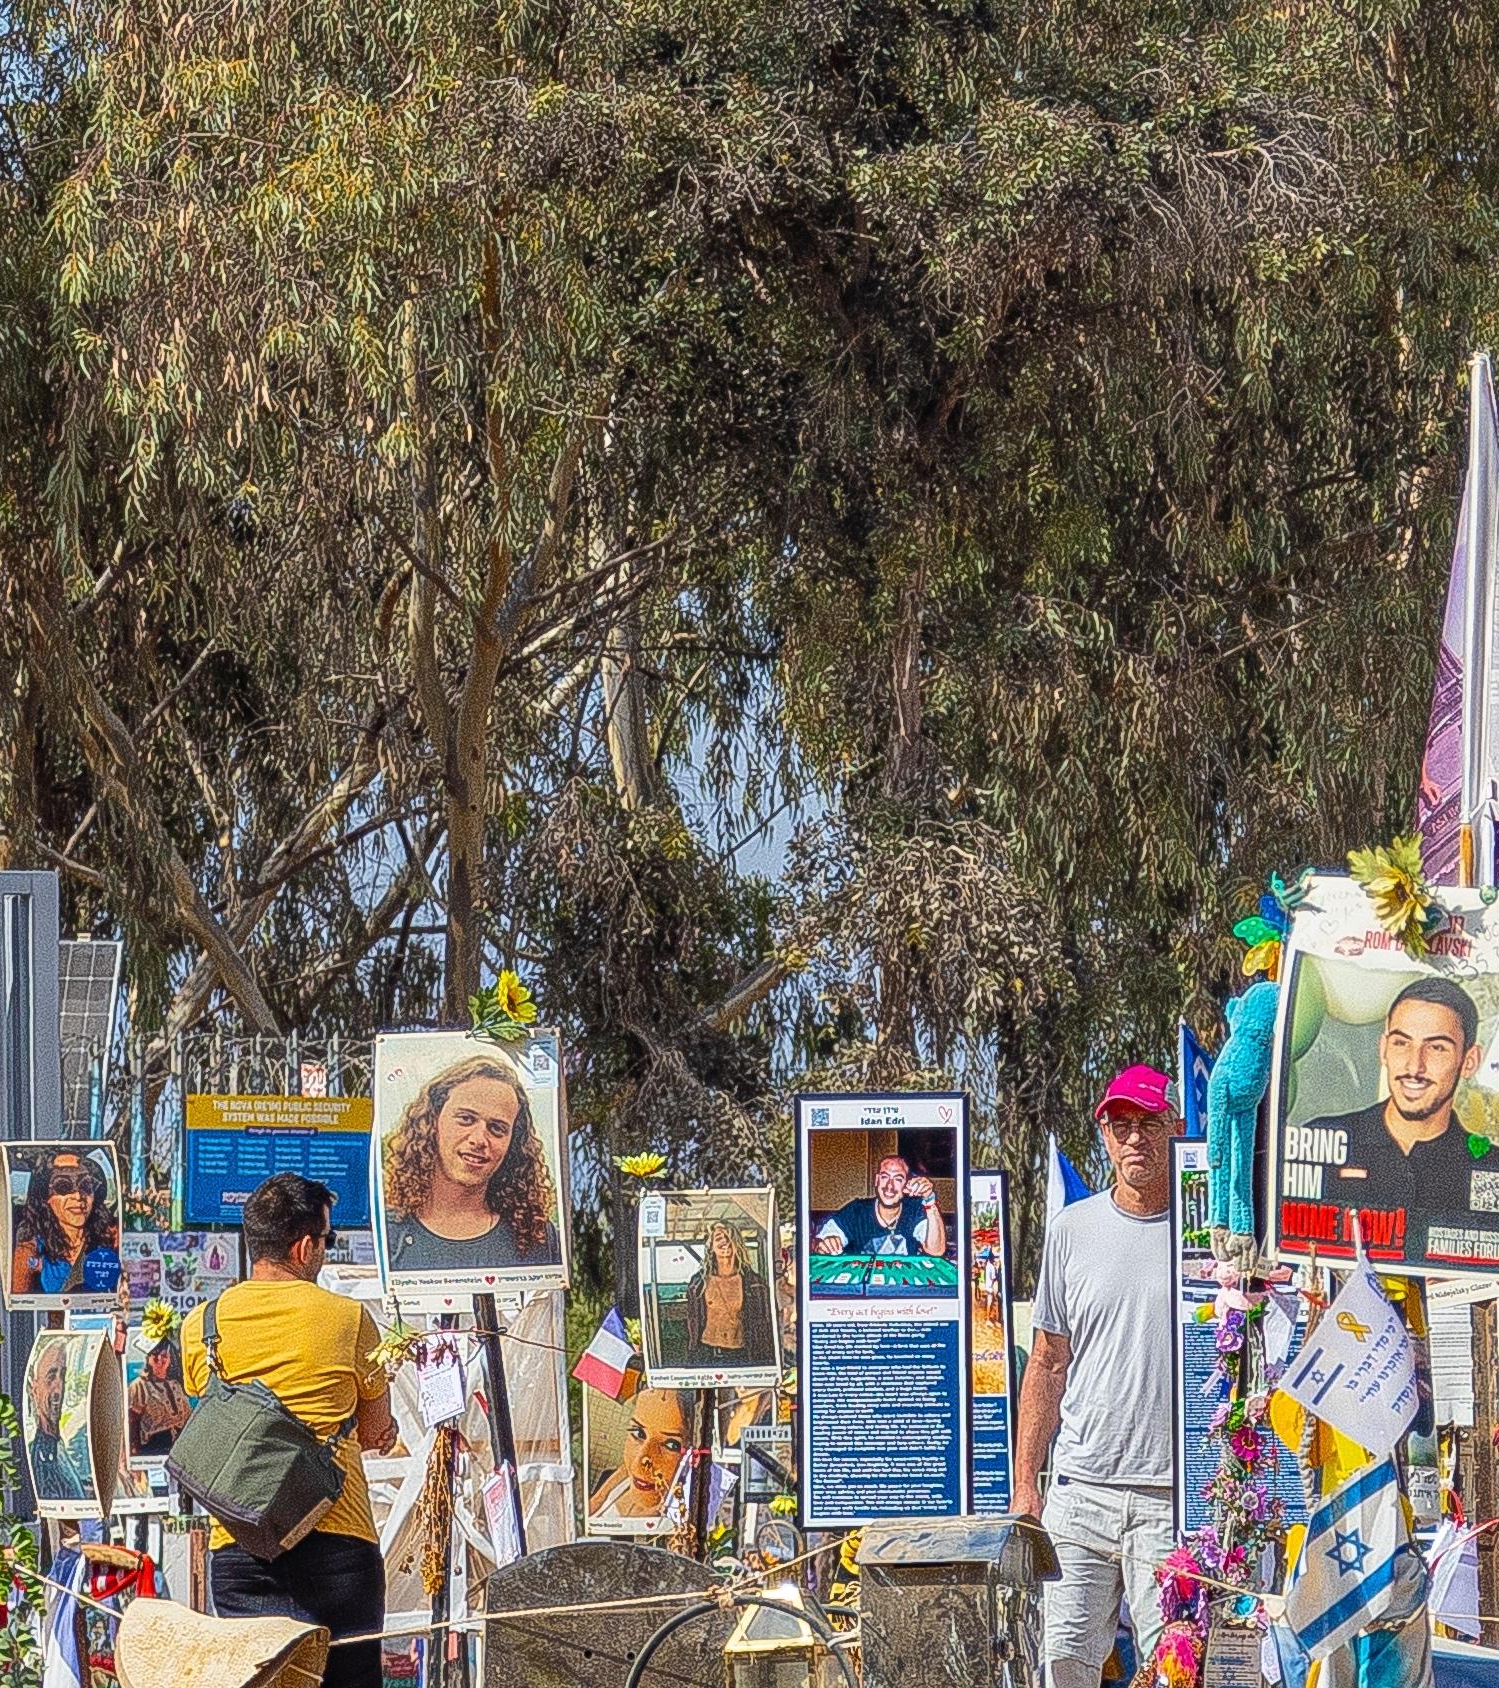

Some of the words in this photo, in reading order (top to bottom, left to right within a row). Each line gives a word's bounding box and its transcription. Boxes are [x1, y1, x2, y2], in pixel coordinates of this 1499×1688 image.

[1365, 931, 1390, 950] ROM
[213, 1101, 228, 1111] THE
[314, 1102, 351, 1112] SECURITY
[223, 1113, 255, 1122] SYSTEM
[258, 1113, 275, 1123] WAS
[277, 1113, 299, 1123] MADE
[861, 1117, 882, 1125] Idan
[1286, 1127, 1348, 1165] BRING
[1284, 1163, 1322, 1199] HIM
[1282, 1202, 1338, 1240] HOME
[1464, 1230, 1478, 1241] AND
[1428, 1238, 1472, 1257] FAMILIES
[855, 1307, 868, 1315] act
[870, 1305, 894, 1318] begins
[897, 1305, 914, 1315] with
